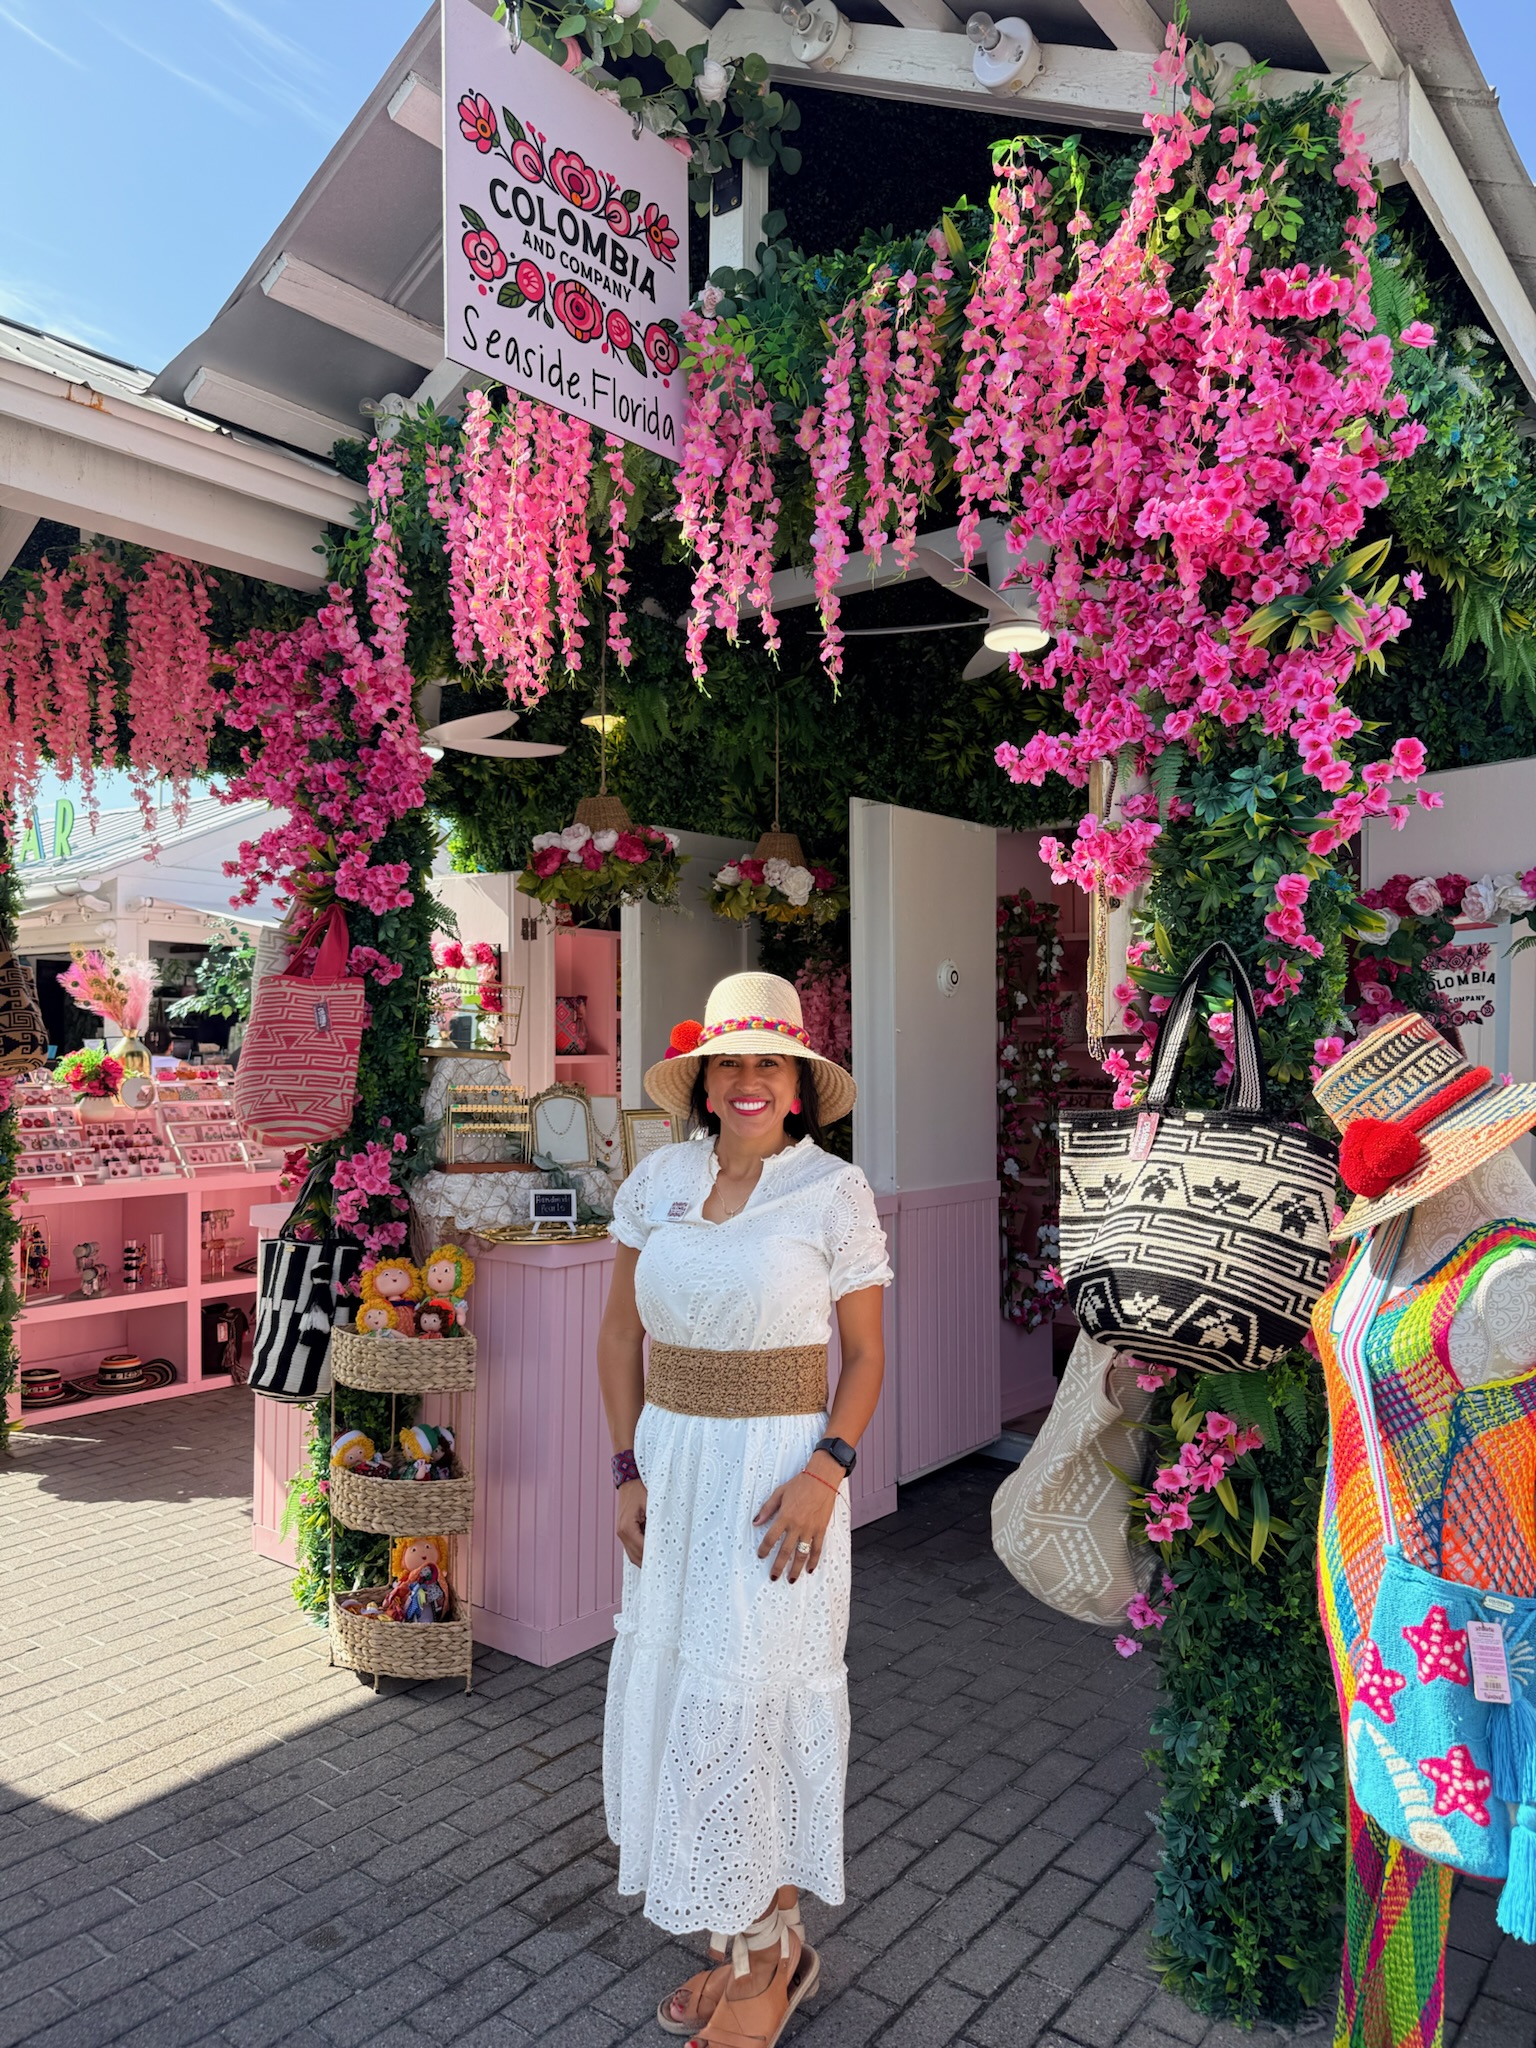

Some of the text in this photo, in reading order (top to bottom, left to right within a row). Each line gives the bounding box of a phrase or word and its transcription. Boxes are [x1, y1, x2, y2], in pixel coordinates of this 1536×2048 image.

[489, 178, 656, 304] COLOMBIA
[522, 229, 632, 303] AND COMPANY
[1448, 995, 1486, 1005] COMPANY
